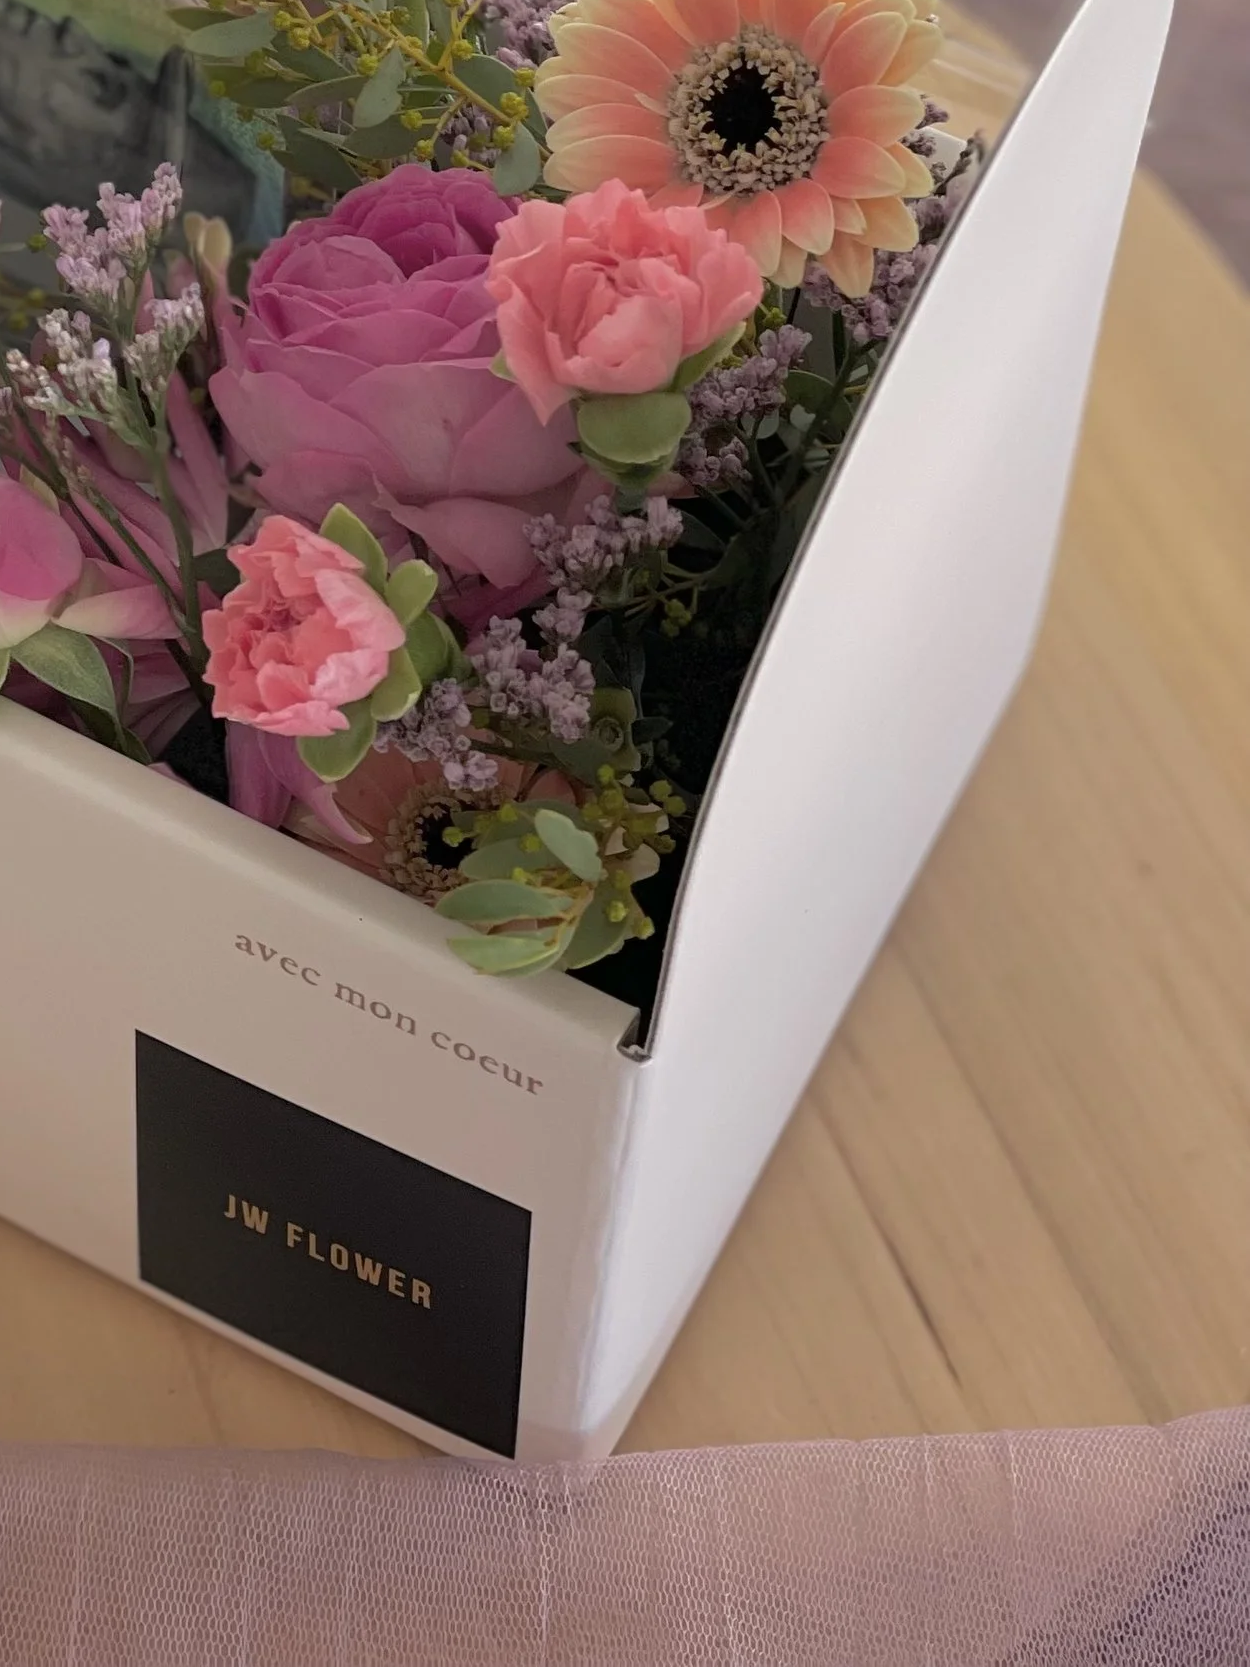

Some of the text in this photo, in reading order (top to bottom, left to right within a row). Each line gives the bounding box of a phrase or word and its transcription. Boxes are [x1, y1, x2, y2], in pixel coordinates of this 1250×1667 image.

[234, 933, 544, 1096] avec mon coeur
[223, 1193, 433, 1310] JW FLOWER
